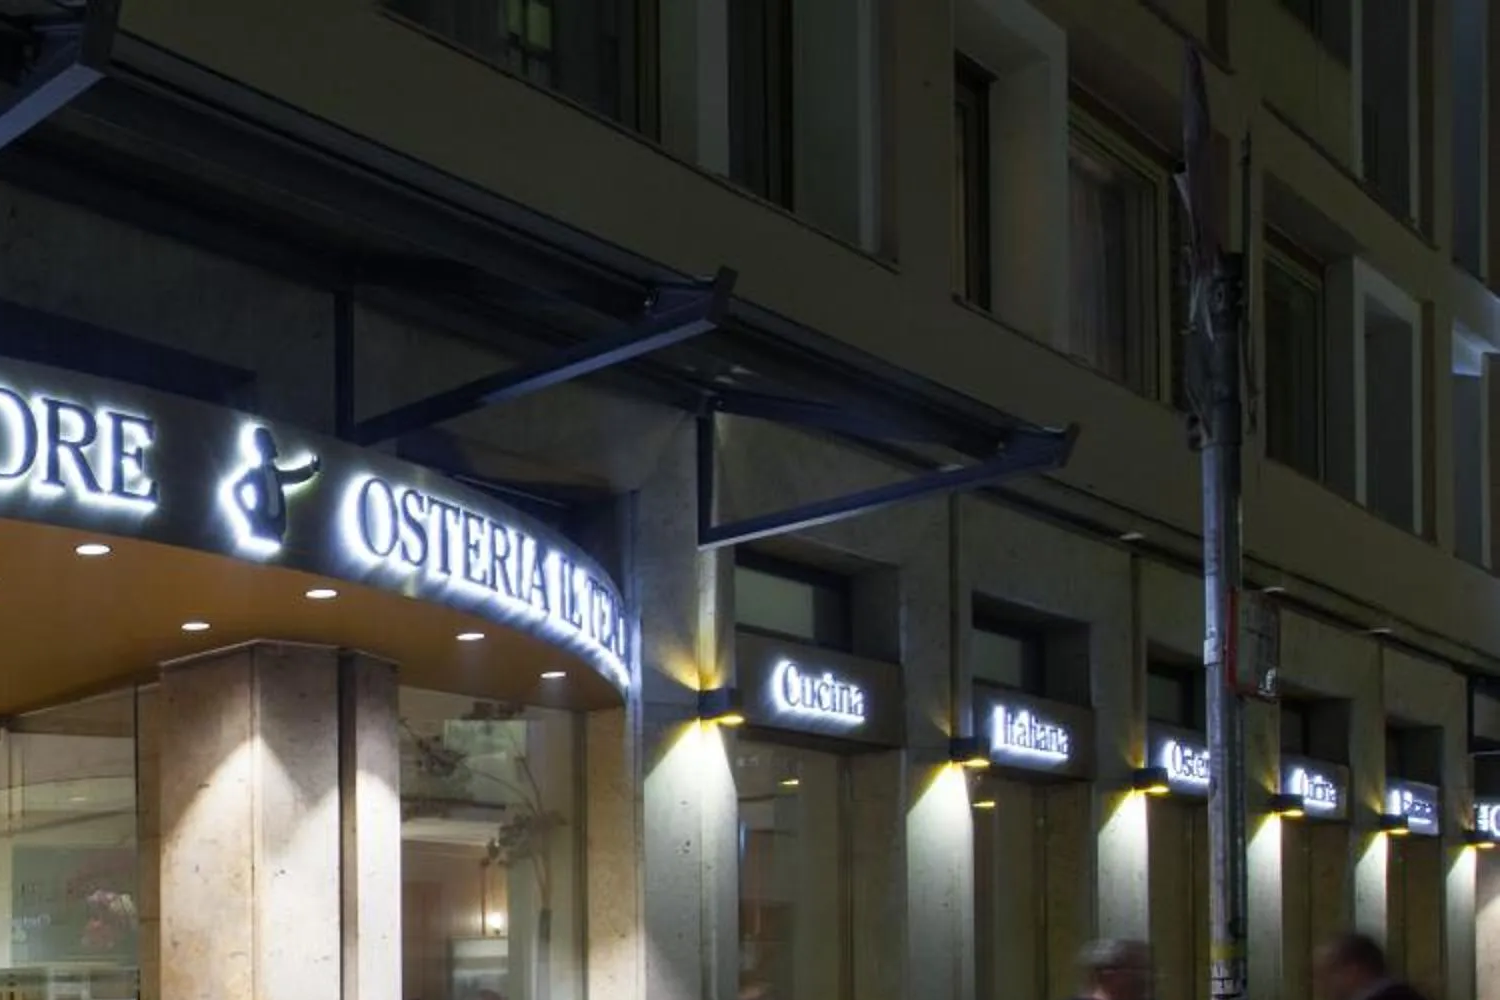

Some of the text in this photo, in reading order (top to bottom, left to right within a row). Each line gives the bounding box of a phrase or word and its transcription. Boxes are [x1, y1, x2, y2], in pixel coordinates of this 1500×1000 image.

[356, 476, 551, 613] OSTERIA
[560, 552, 583, 632] IL
[780, 662, 864, 717] Cucina
